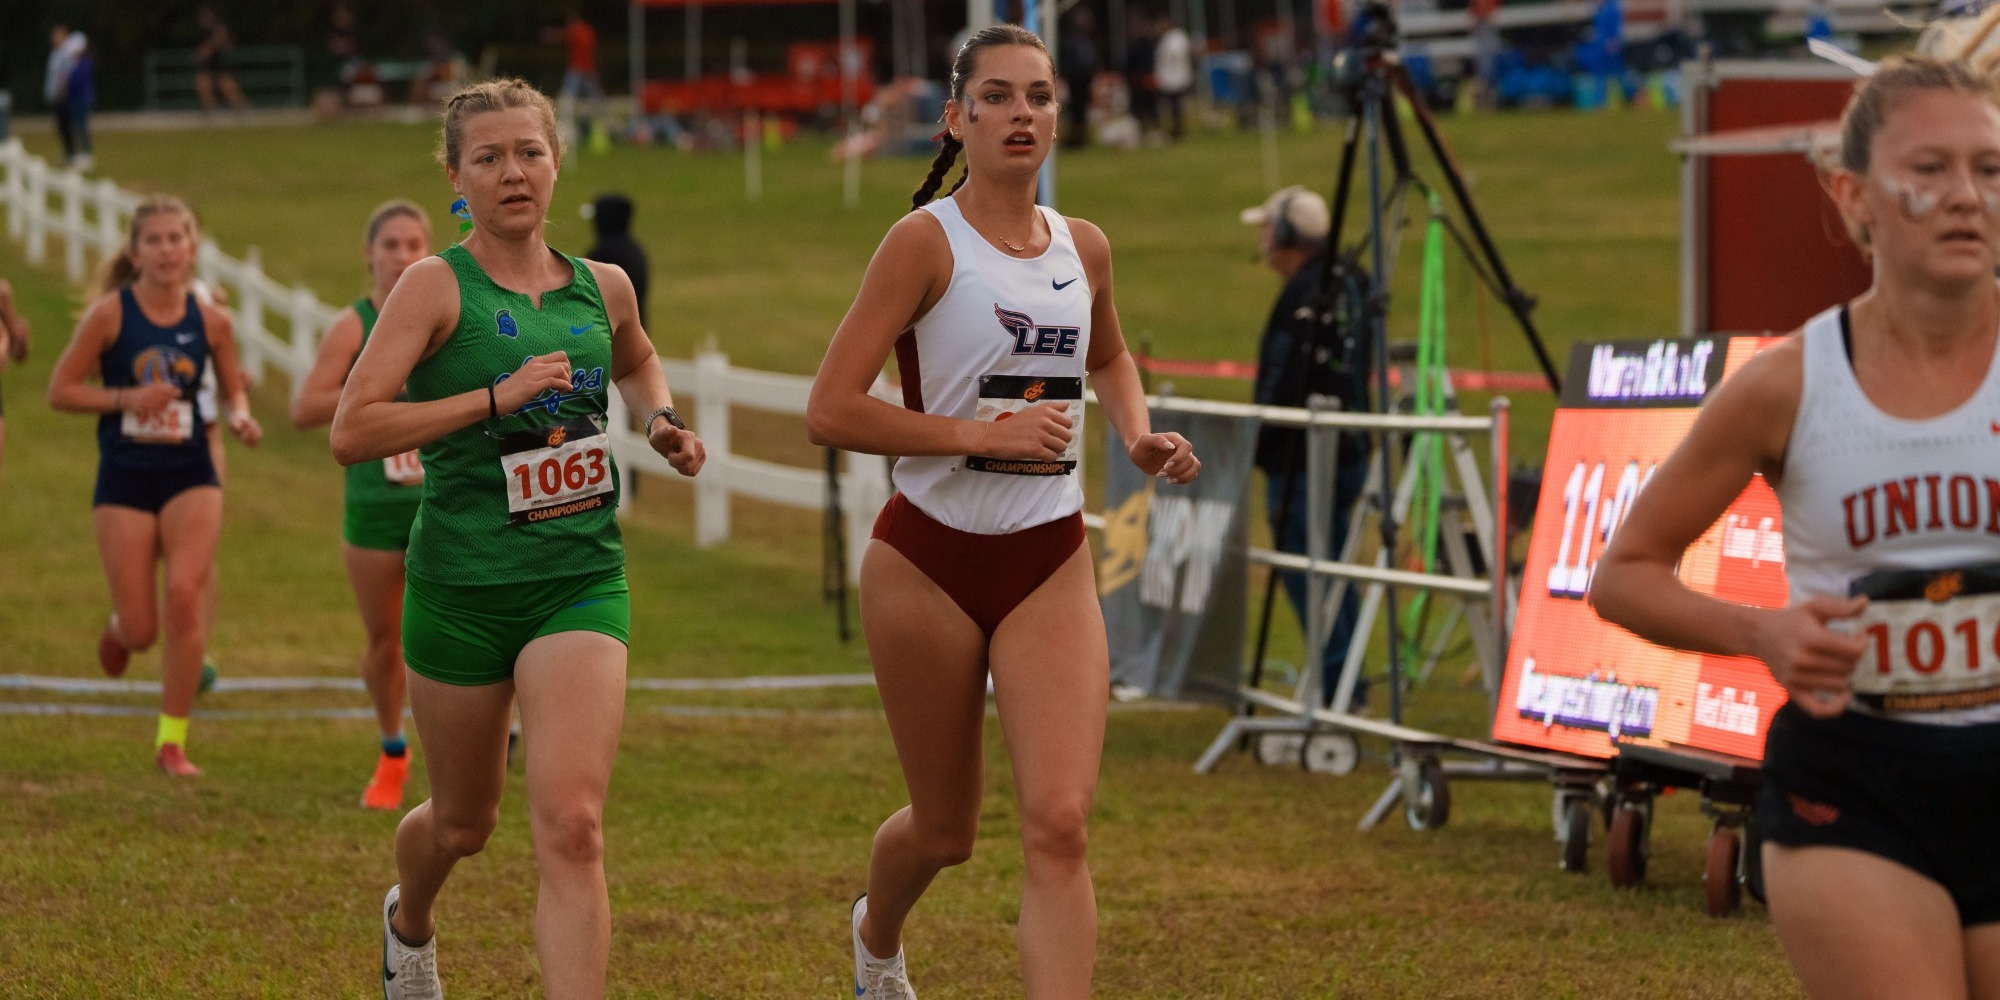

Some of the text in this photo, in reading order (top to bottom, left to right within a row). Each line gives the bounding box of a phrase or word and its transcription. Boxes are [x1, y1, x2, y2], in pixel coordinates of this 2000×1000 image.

[1010, 325, 1081, 357] LEE
[513, 448, 606, 500] 1063
[985, 460, 1066, 474] CHAMPIONSHIPS
[527, 496, 602, 522] CHAMPIONSHIPS
[1866, 617, 2000, 676] 101
